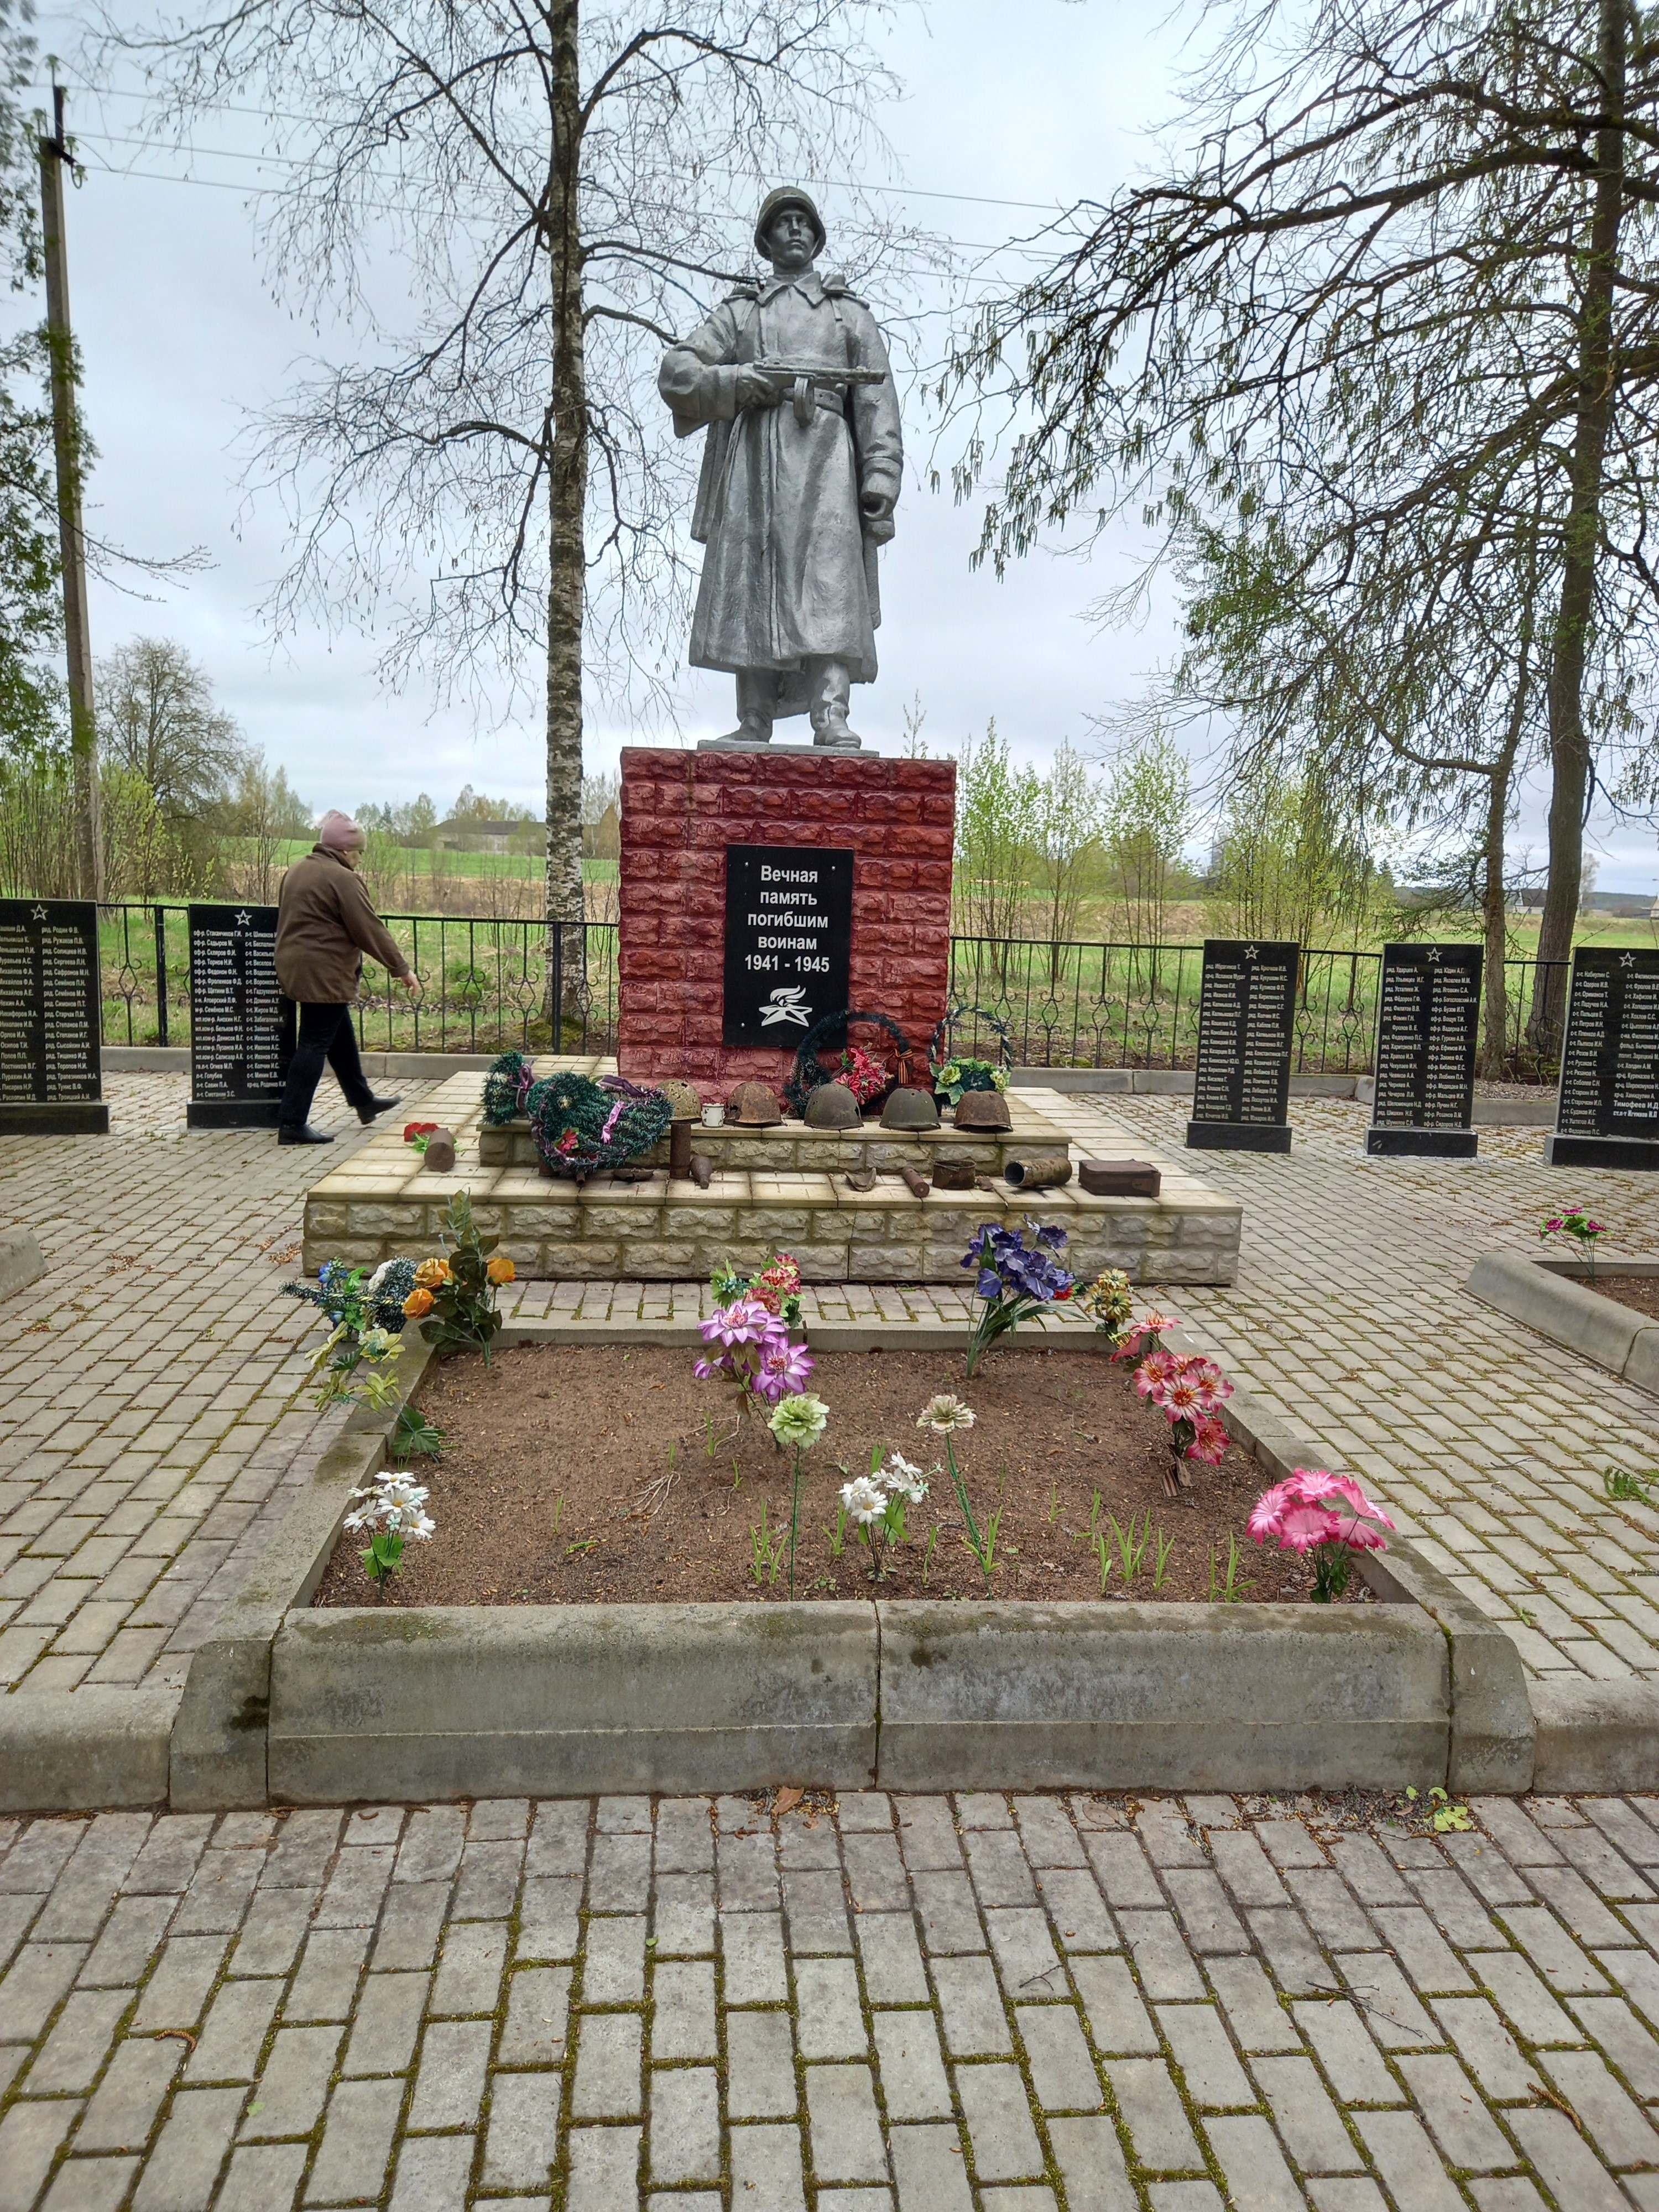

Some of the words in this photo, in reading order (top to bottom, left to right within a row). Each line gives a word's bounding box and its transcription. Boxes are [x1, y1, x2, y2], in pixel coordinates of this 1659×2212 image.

[761, 865, 818, 883] Вечная
[760, 891, 817, 905] память
[748, 911, 828, 928] погибшим
[758, 936, 817, 950] воинам
[744, 954, 779, 971] 1941
[795, 956, 830, 972] 1945
[1613, 1100, 1645, 1108] Тимофеев
